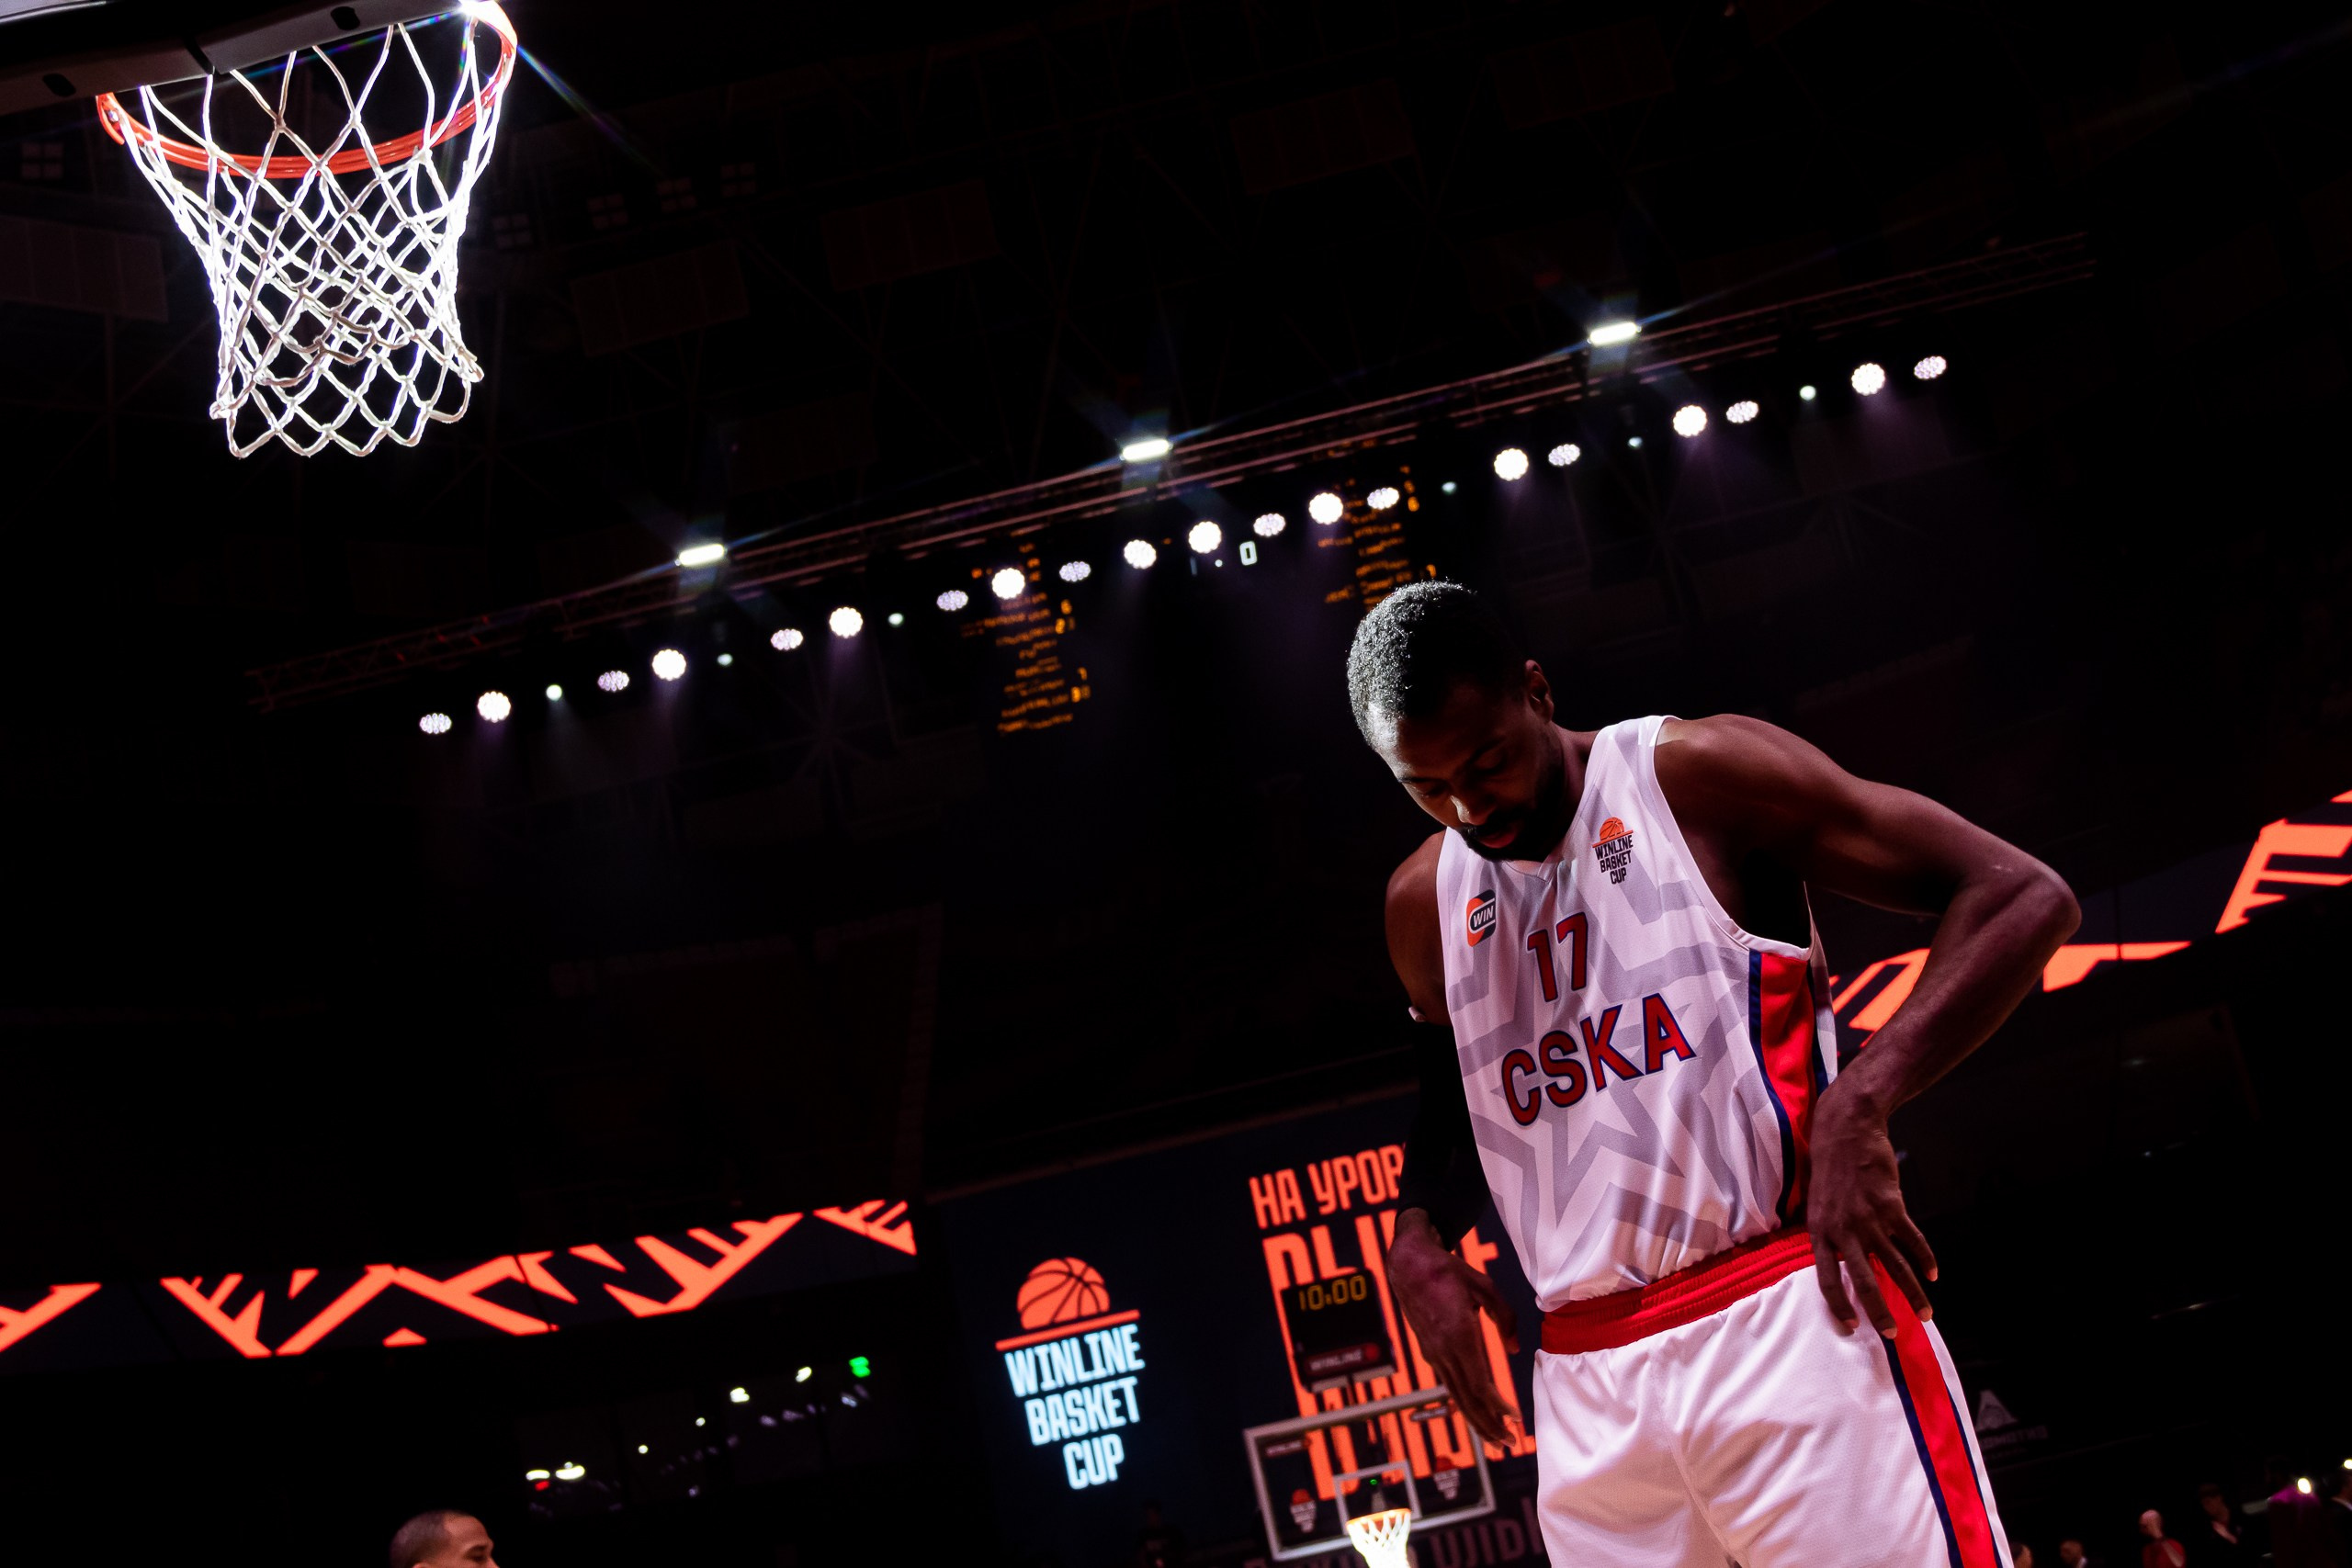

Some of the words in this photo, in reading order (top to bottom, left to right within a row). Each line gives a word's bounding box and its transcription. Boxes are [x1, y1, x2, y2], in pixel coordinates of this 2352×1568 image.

[1595, 835, 1634, 860] WINLINE
[1600, 850, 1632, 874] BASKET
[1610, 867, 1627, 885] CUP
[1474, 905, 1494, 928] WIN
[1526, 911, 1589, 1002] 17
[1501, 992, 1697, 1126] CSKA
[1249, 1168, 1306, 1229] НА
[1306, 1142, 1406, 1215] УРОВ
[1003, 1323, 1147, 1398] WINLINE
[1024, 1375, 1141, 1447] BASKET
[1062, 1433, 1125, 1490] CUP
